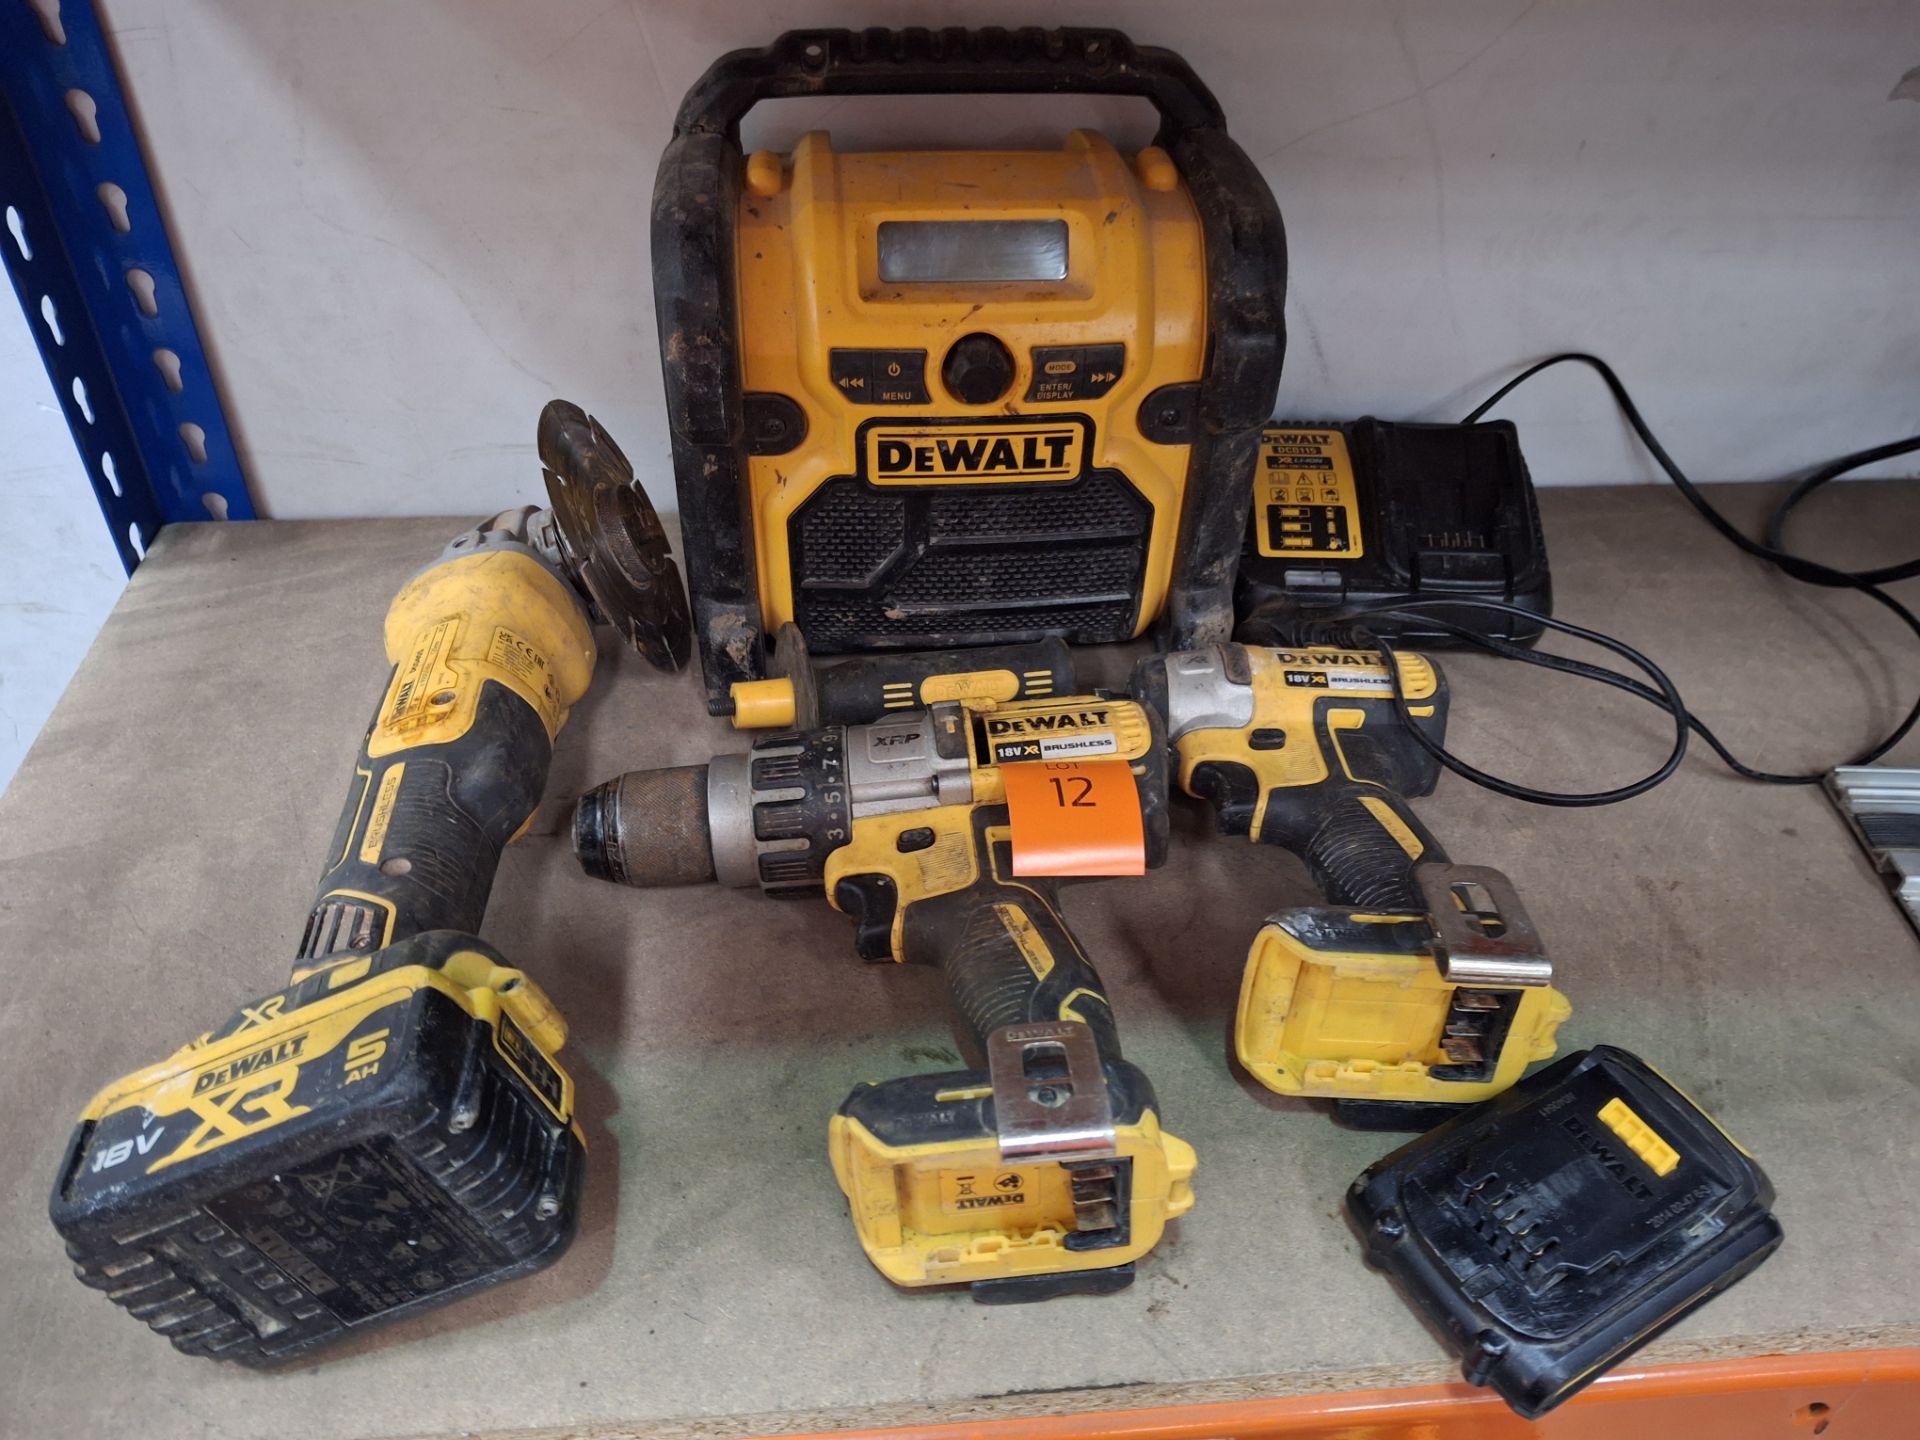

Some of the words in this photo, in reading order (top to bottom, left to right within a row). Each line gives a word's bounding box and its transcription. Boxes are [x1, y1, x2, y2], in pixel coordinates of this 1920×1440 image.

[1048, 363, 1073, 371] MODE
[1036, 390, 1074, 399] DISPLAY
[1039, 383, 1072, 391] ENTER/
[882, 391, 912, 401] MENU
[877, 436, 1073, 473] DEWALT
[1287, 674, 1309, 683] 18V
[988, 711, 1109, 735] DEWALT
[998, 747, 1022, 757] 18V
[1043, 739, 1113, 752] BRUSHLESS
[822, 758, 840, 770] 7
[1045, 762, 1079, 770] LOT
[824, 791, 841, 803] 5
[1049, 776, 1096, 808] 12
[828, 828, 844, 840] 3
[233, 995, 286, 1035] XR
[344, 1028, 390, 1070] 5
[193, 1034, 307, 1094] DEWALT
[345, 1063, 379, 1085] AH
[91, 1126, 165, 1172] 18V
